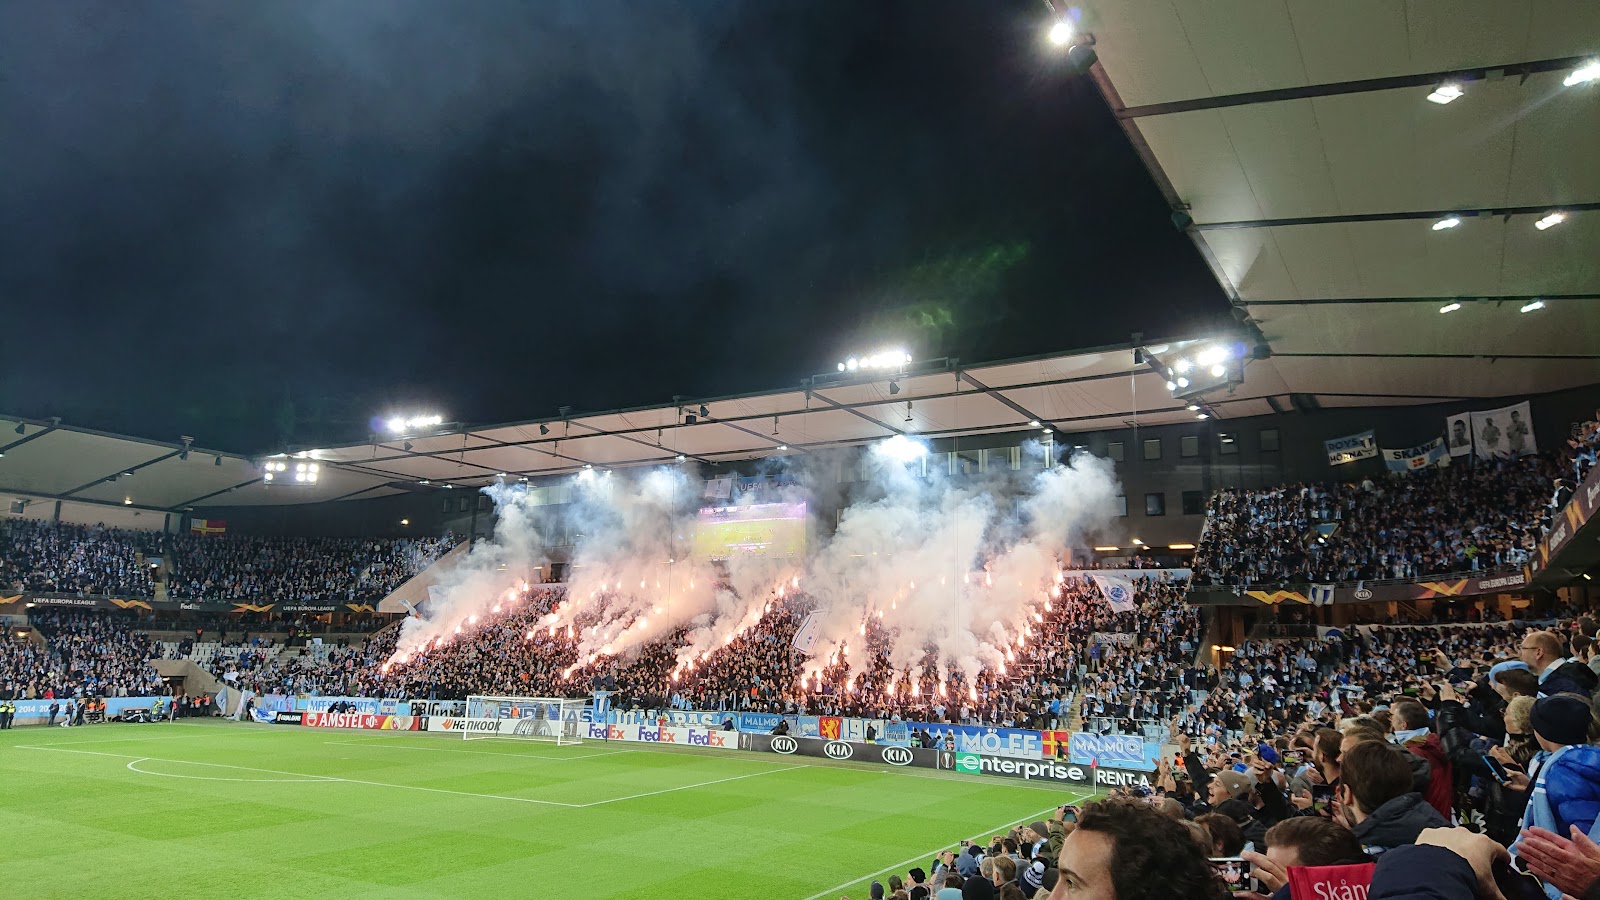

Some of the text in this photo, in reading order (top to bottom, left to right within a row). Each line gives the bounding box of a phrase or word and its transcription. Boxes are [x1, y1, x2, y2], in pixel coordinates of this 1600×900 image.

[18, 705, 36, 713] 2014
[319, 713, 364, 729] AMSTEL
[588, 723, 625, 740] FedEx
[638, 725, 676, 743] FedEx
[688, 728, 725, 747] FedEx
[1008, 733, 1038, 755] FF
[958, 755, 1084, 780] enterprise
[1313, 878, 1371, 900] Skån
